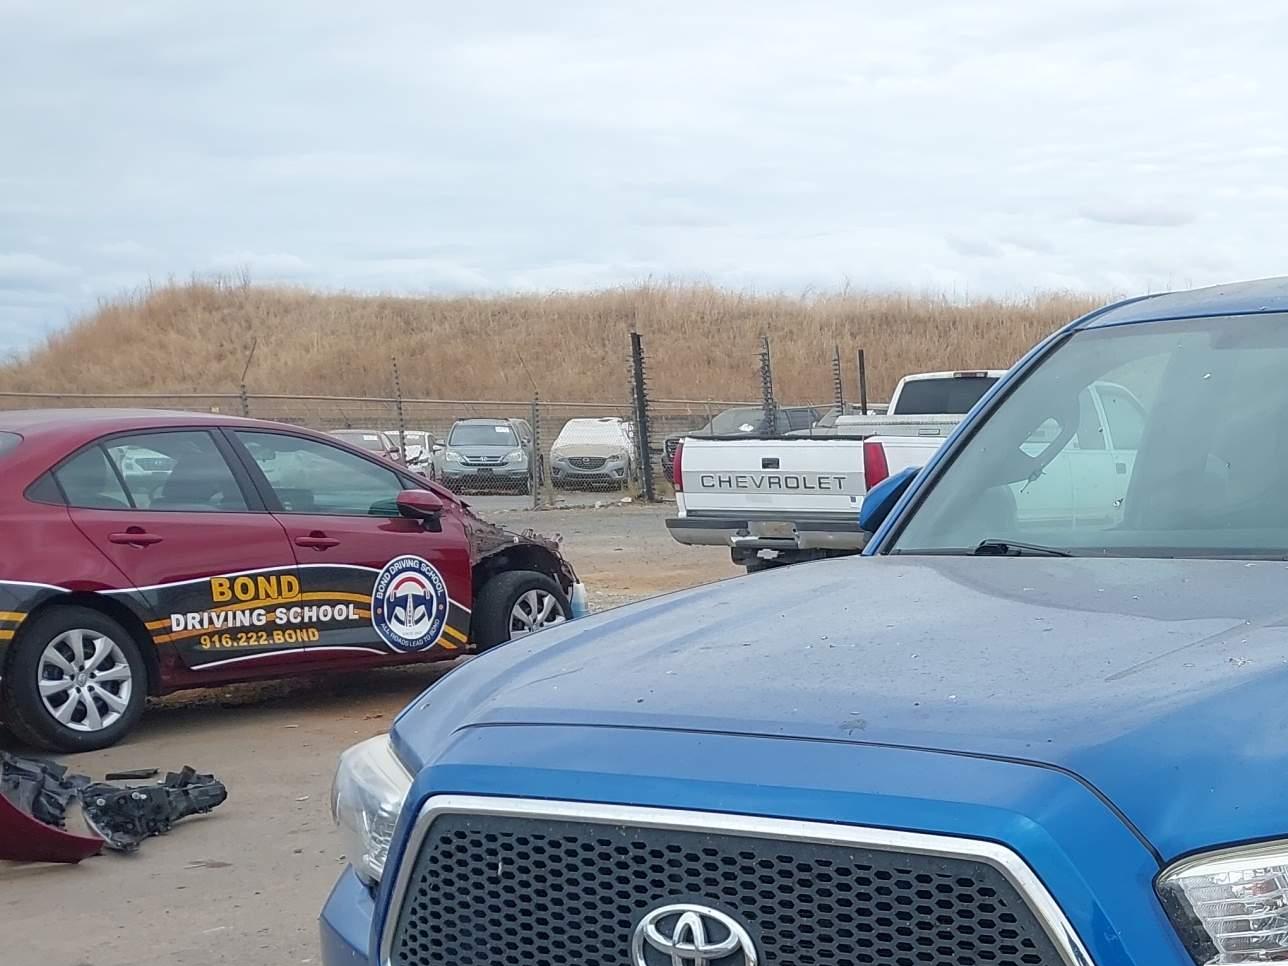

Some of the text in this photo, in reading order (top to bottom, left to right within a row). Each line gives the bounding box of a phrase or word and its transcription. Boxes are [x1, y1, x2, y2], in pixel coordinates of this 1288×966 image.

[700, 474, 848, 490] CHEVROLET
[210, 575, 300, 602] BOND
[376, 559, 444, 599] BOND DRIVING SCHOOL
[170, 603, 360, 632] DRIVING SCHOOL
[200, 628, 320, 649] 916.222.BOND
